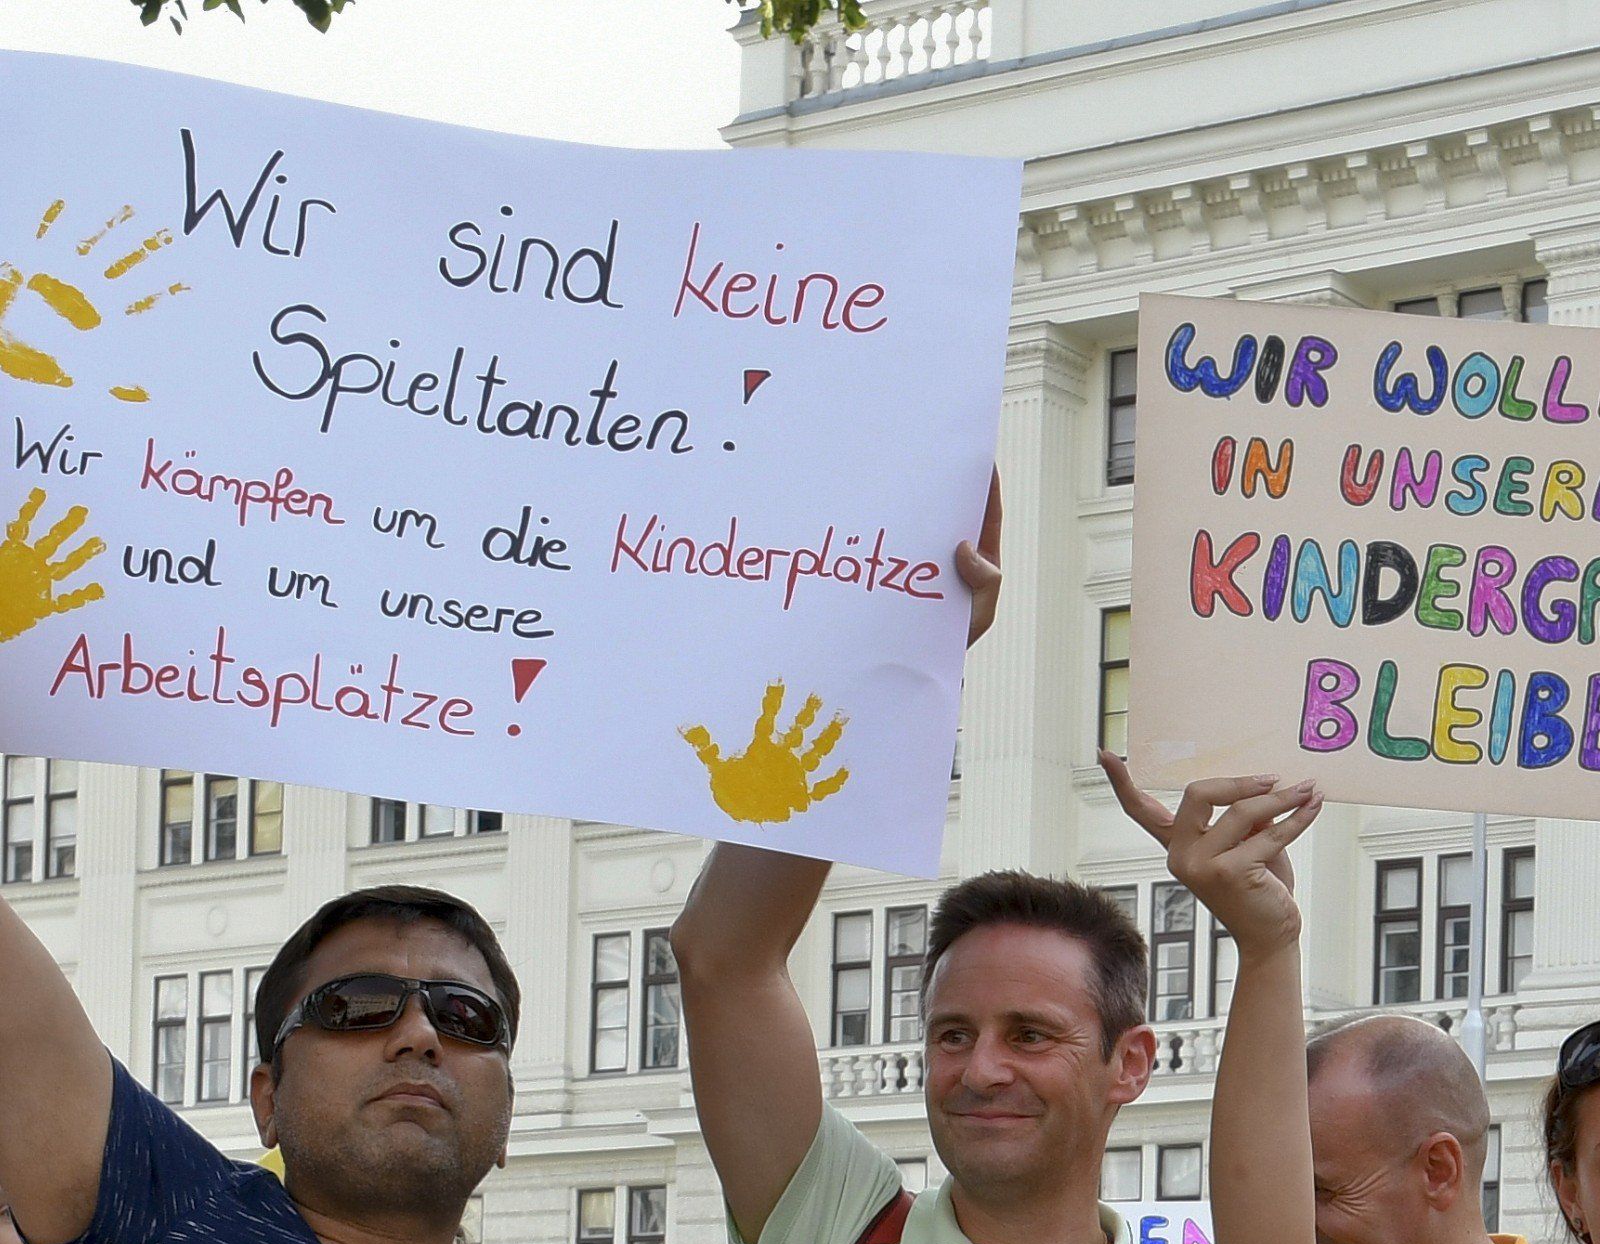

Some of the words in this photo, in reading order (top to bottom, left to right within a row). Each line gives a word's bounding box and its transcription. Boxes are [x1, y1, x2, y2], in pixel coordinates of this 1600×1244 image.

[180, 129, 336, 257] Wir
[439, 206, 623, 308] sind
[674, 223, 887, 332] keine
[1165, 323, 1338, 407] WIR
[16, 417, 102, 475] Wir
[141, 438, 345, 526] kämpfen
[373, 501, 445, 548] um
[482, 506, 571, 570] die
[611, 514, 944, 610] Kinderplätze
[1212, 436, 1294, 499] IN
[123, 539, 222, 586] und
[269, 564, 338, 608] um
[381, 584, 554, 638] unsere
